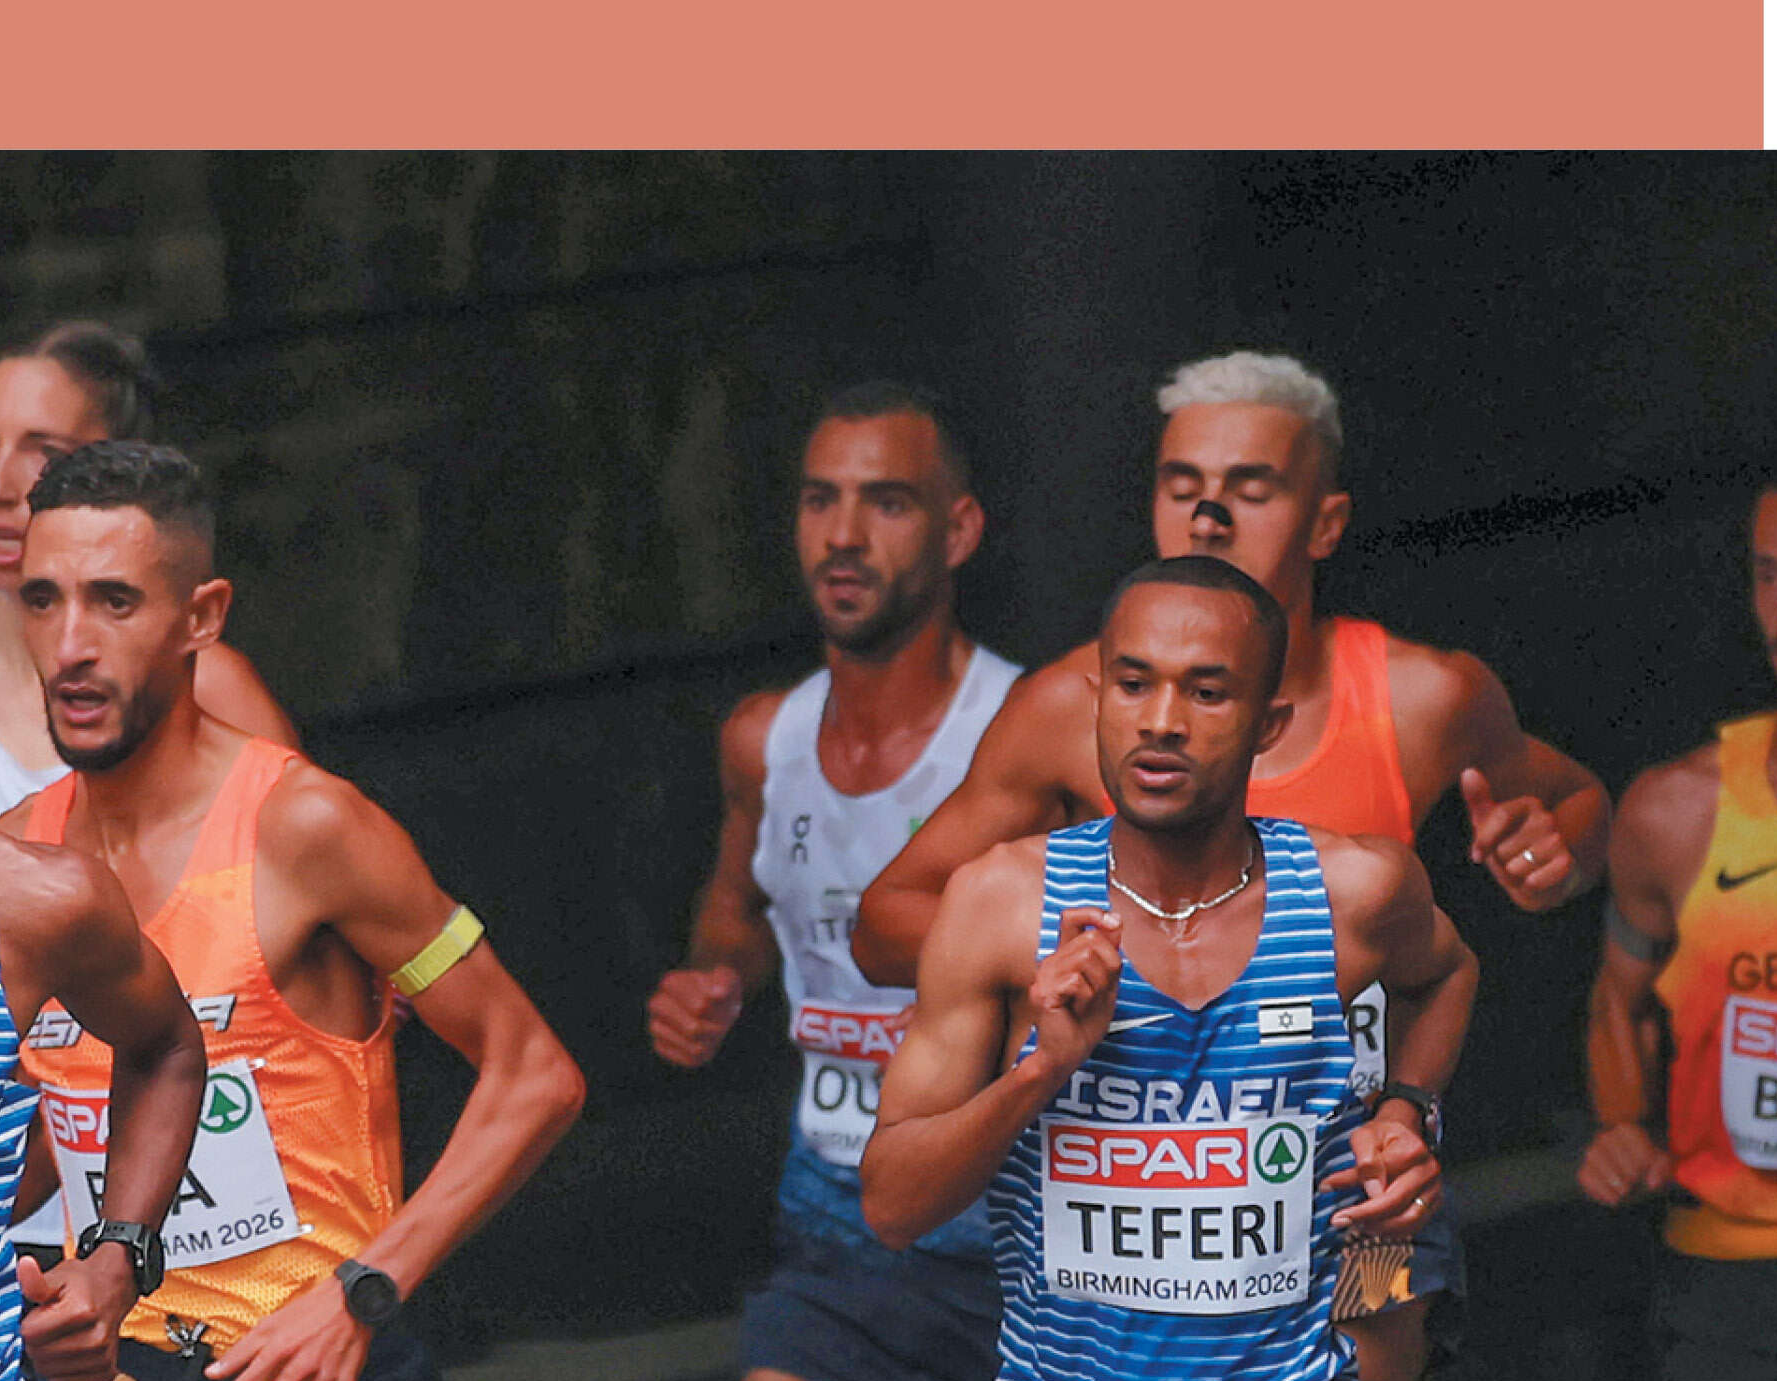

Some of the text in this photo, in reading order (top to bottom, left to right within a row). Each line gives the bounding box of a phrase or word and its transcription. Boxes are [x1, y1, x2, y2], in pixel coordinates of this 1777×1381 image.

[798, 1013, 905, 1056] SPA
[1056, 1070, 1302, 1122] ISRAEL
[1054, 1133, 1244, 1180] SPAR
[217, 1207, 285, 1245] 2026
[1066, 1200, 1286, 1260] TEFERI
[1057, 1268, 1299, 1300] BIRMINGHAM 2026
